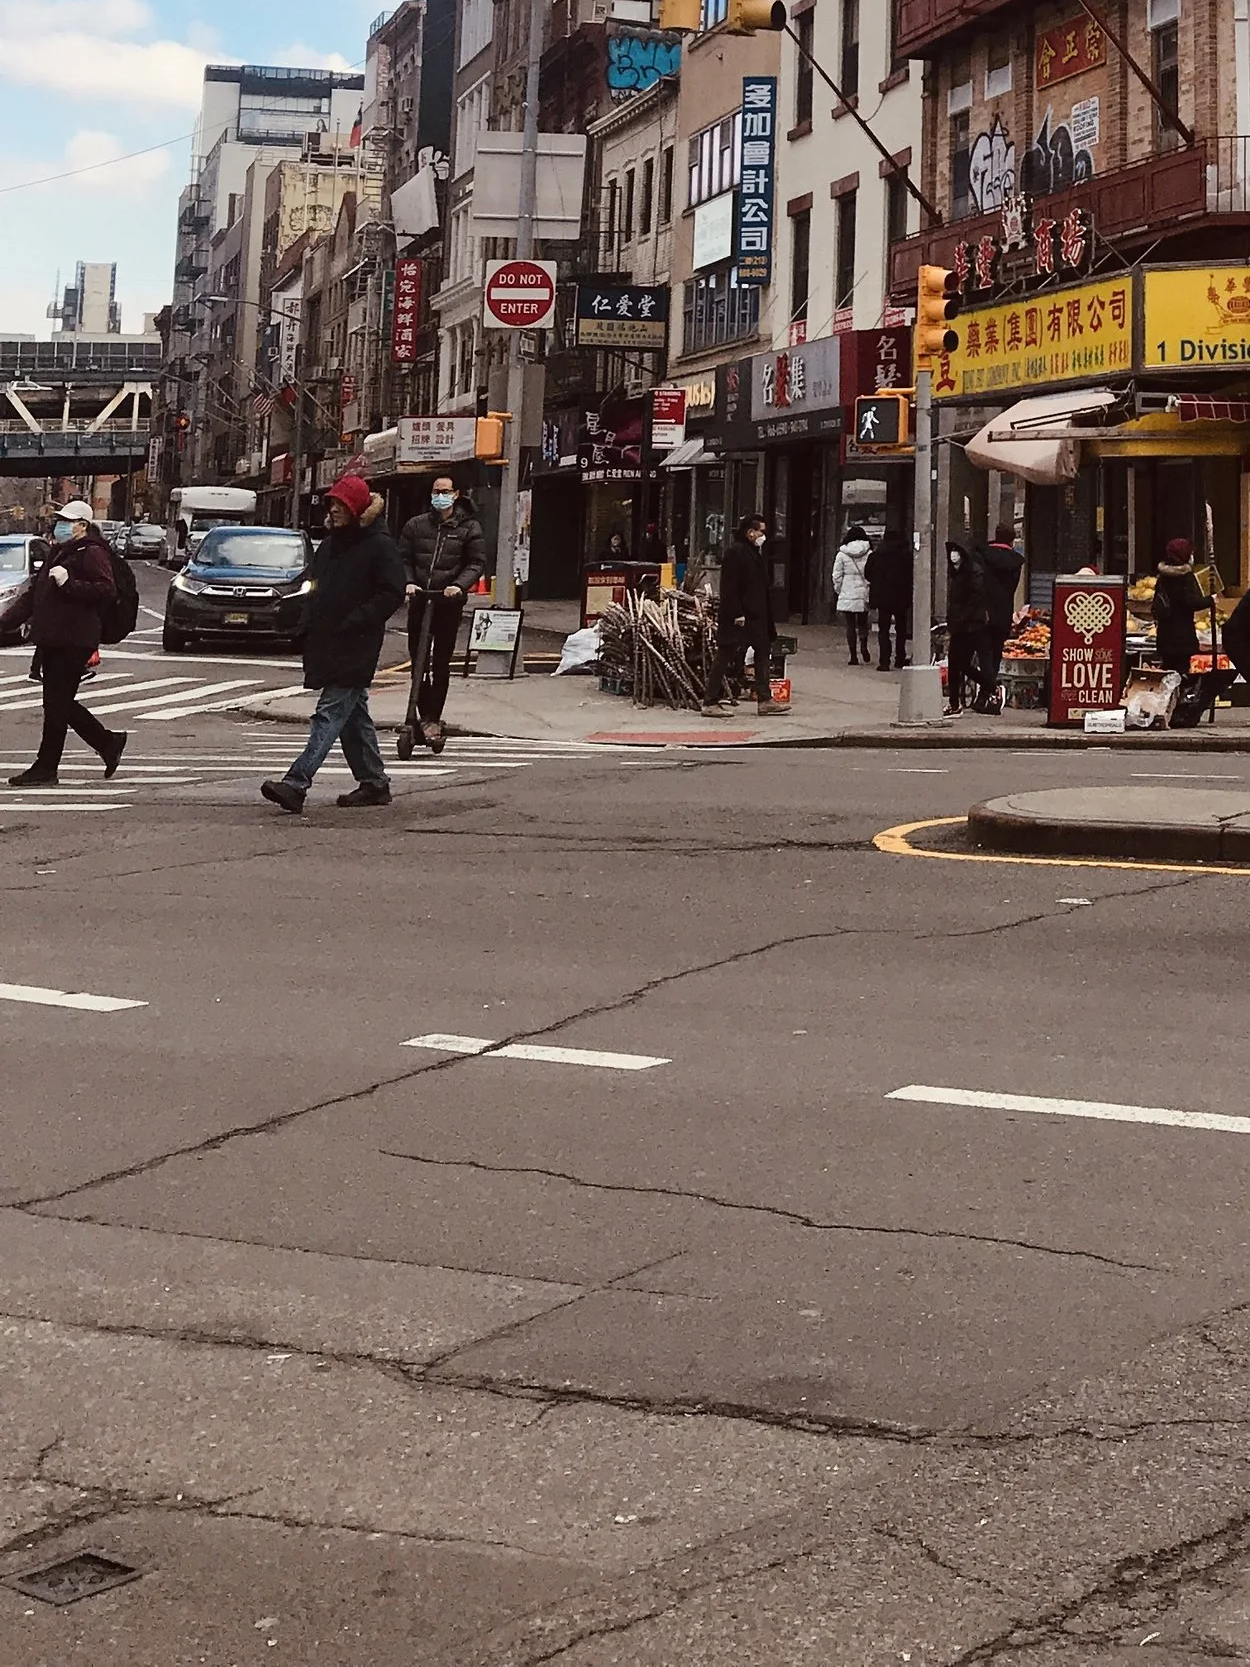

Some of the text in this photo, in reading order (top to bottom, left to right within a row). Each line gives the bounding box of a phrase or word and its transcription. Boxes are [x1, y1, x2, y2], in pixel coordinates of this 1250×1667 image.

[741, 83, 772, 251] 多加會計公司
[499, 274, 543, 285] DO NOT
[500, 303, 539, 314] ENTER
[1157, 340, 1167, 362] 1
[580, 457, 589, 469] 9
[1062, 647, 1094, 662] SHOW
[1061, 663, 1114, 688] LOVE
[1078, 689, 1113, 704] CLEAN
